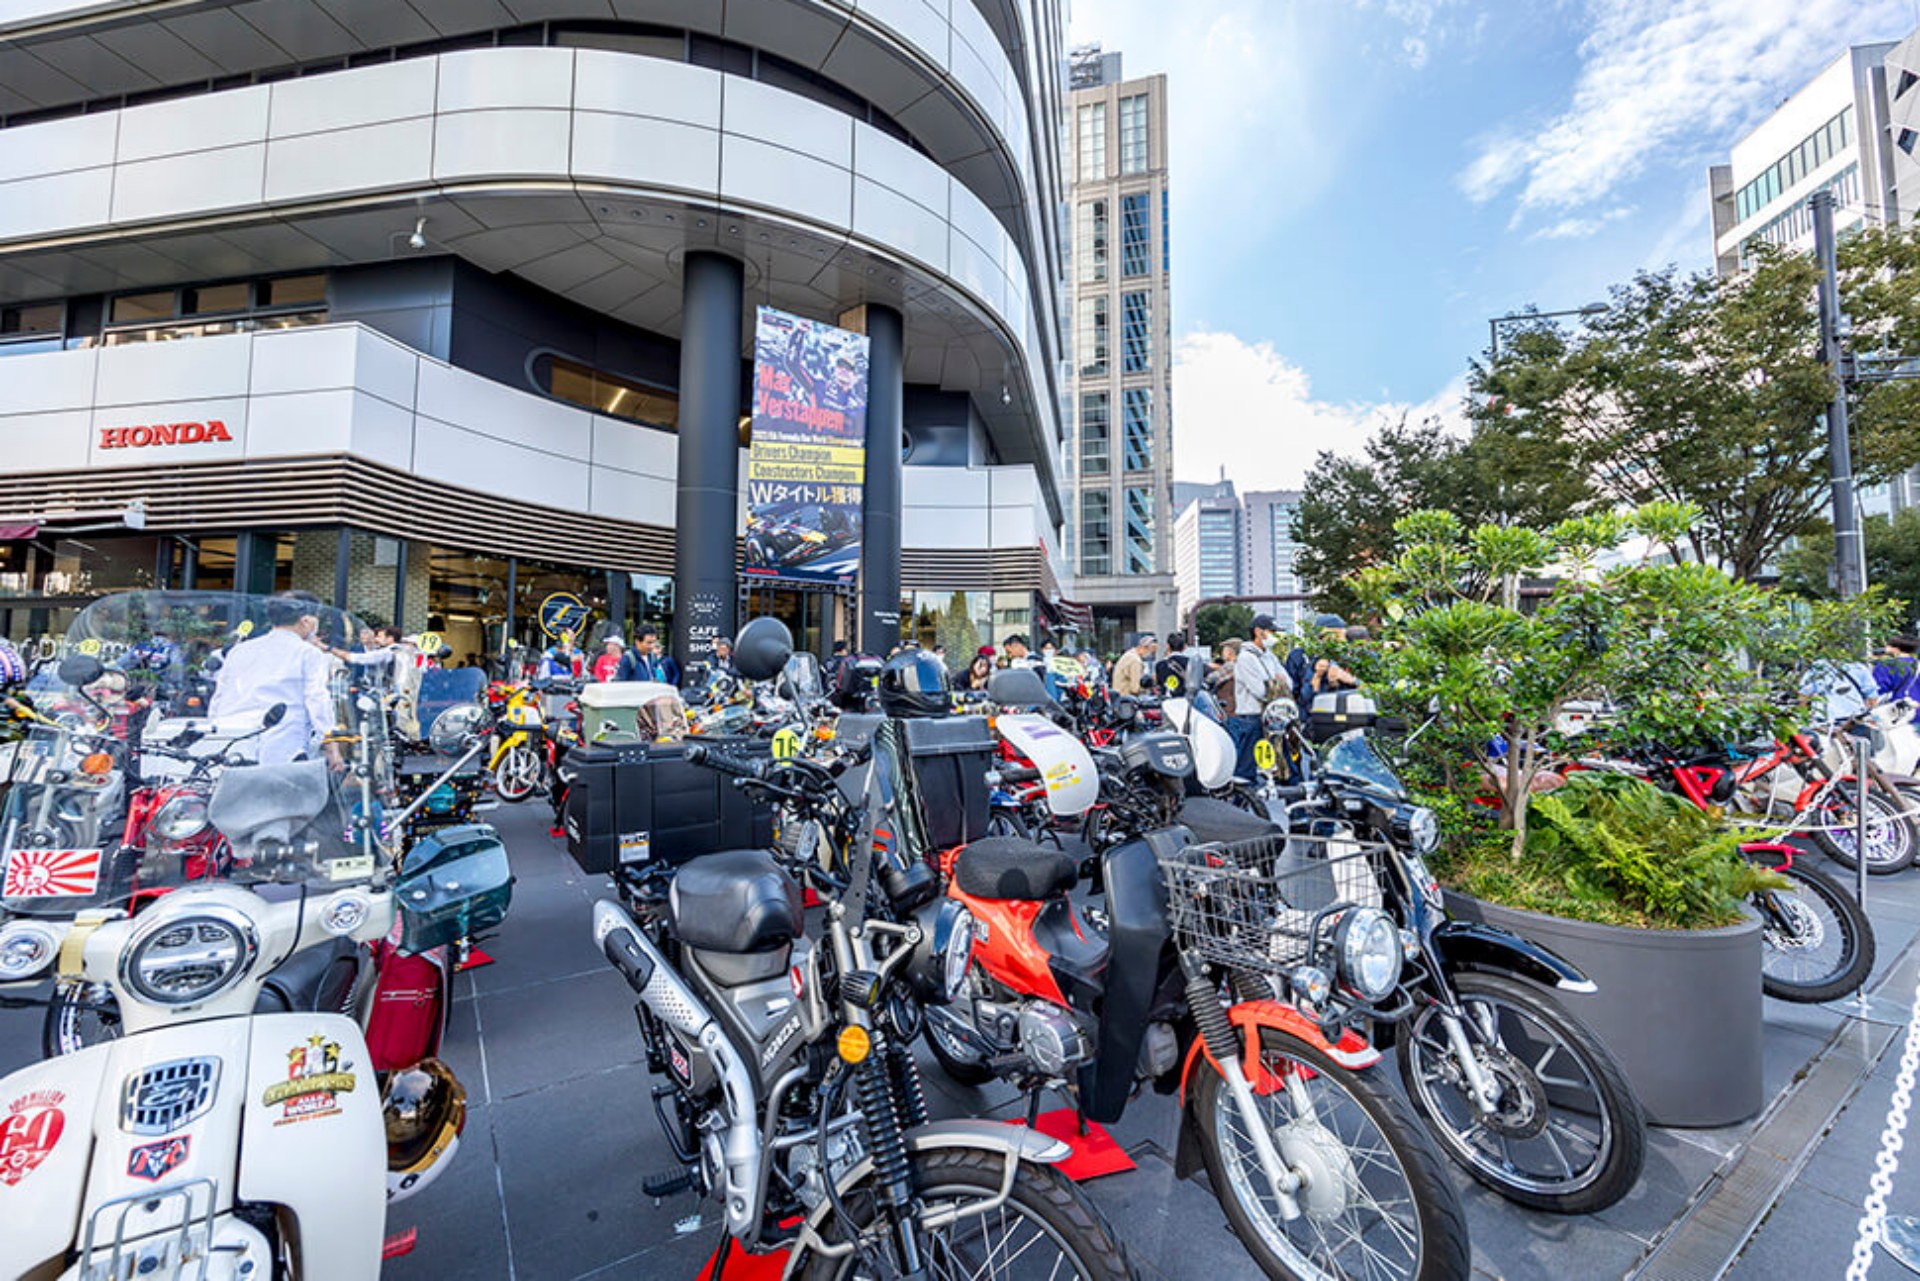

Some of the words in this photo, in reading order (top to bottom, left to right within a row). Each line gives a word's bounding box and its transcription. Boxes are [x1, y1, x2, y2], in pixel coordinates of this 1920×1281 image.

[759, 362, 793, 393] Max
[758, 389, 844, 432] Verstappen
[99, 420, 232, 449] HONDA
[689, 626, 719, 636] CAFE
